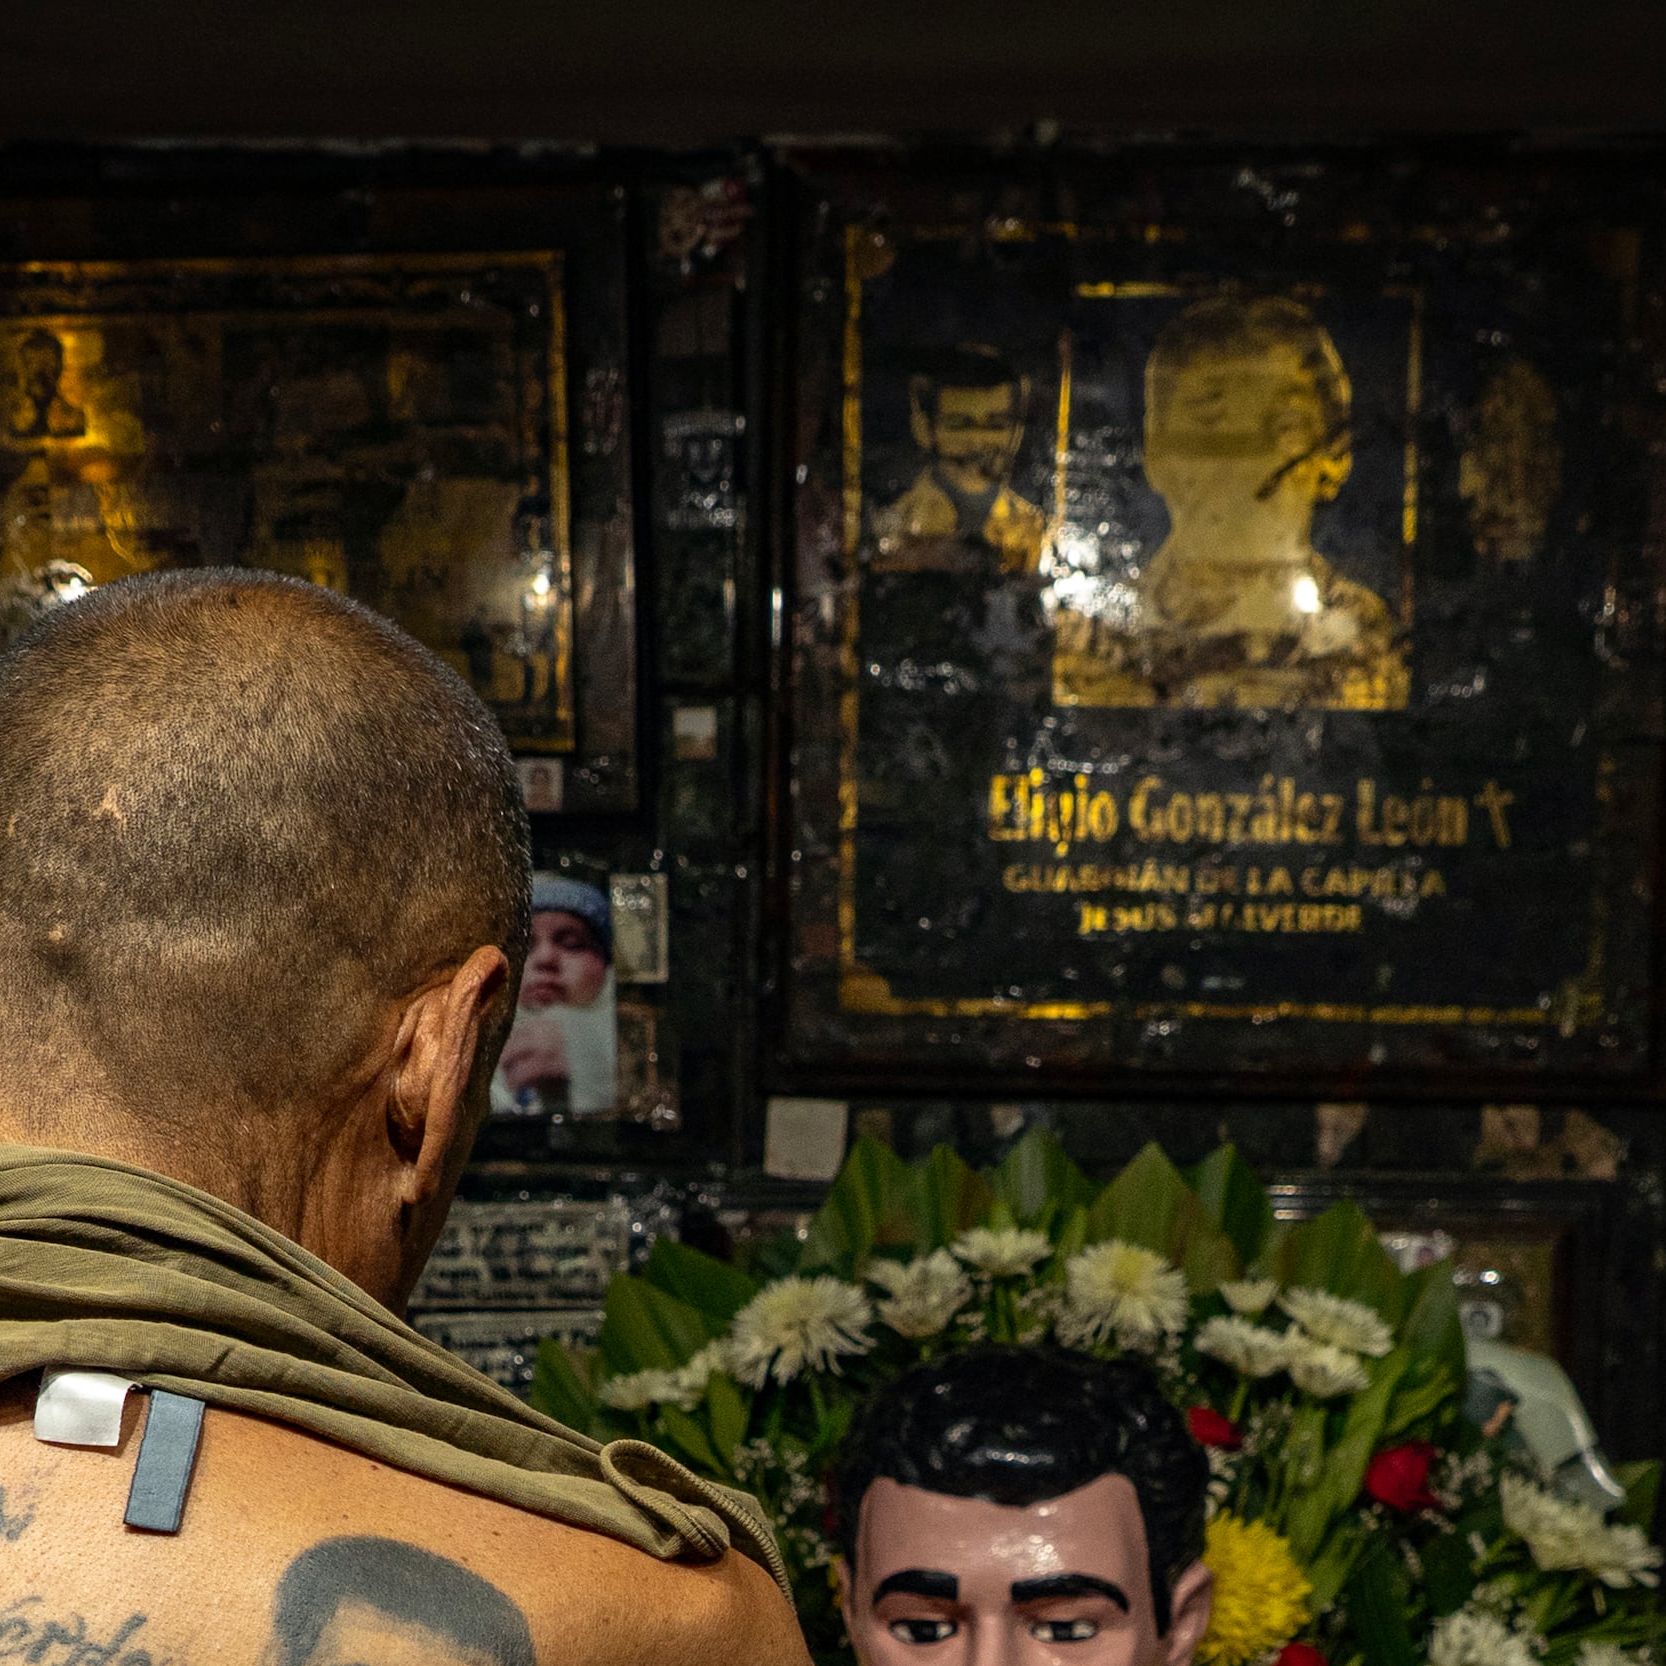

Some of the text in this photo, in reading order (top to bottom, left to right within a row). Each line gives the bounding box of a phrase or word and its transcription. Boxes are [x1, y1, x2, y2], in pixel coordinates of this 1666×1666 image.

[1129, 772, 1345, 846] González
[1356, 776, 1470, 848] León
[1245, 866, 1296, 896] LA
